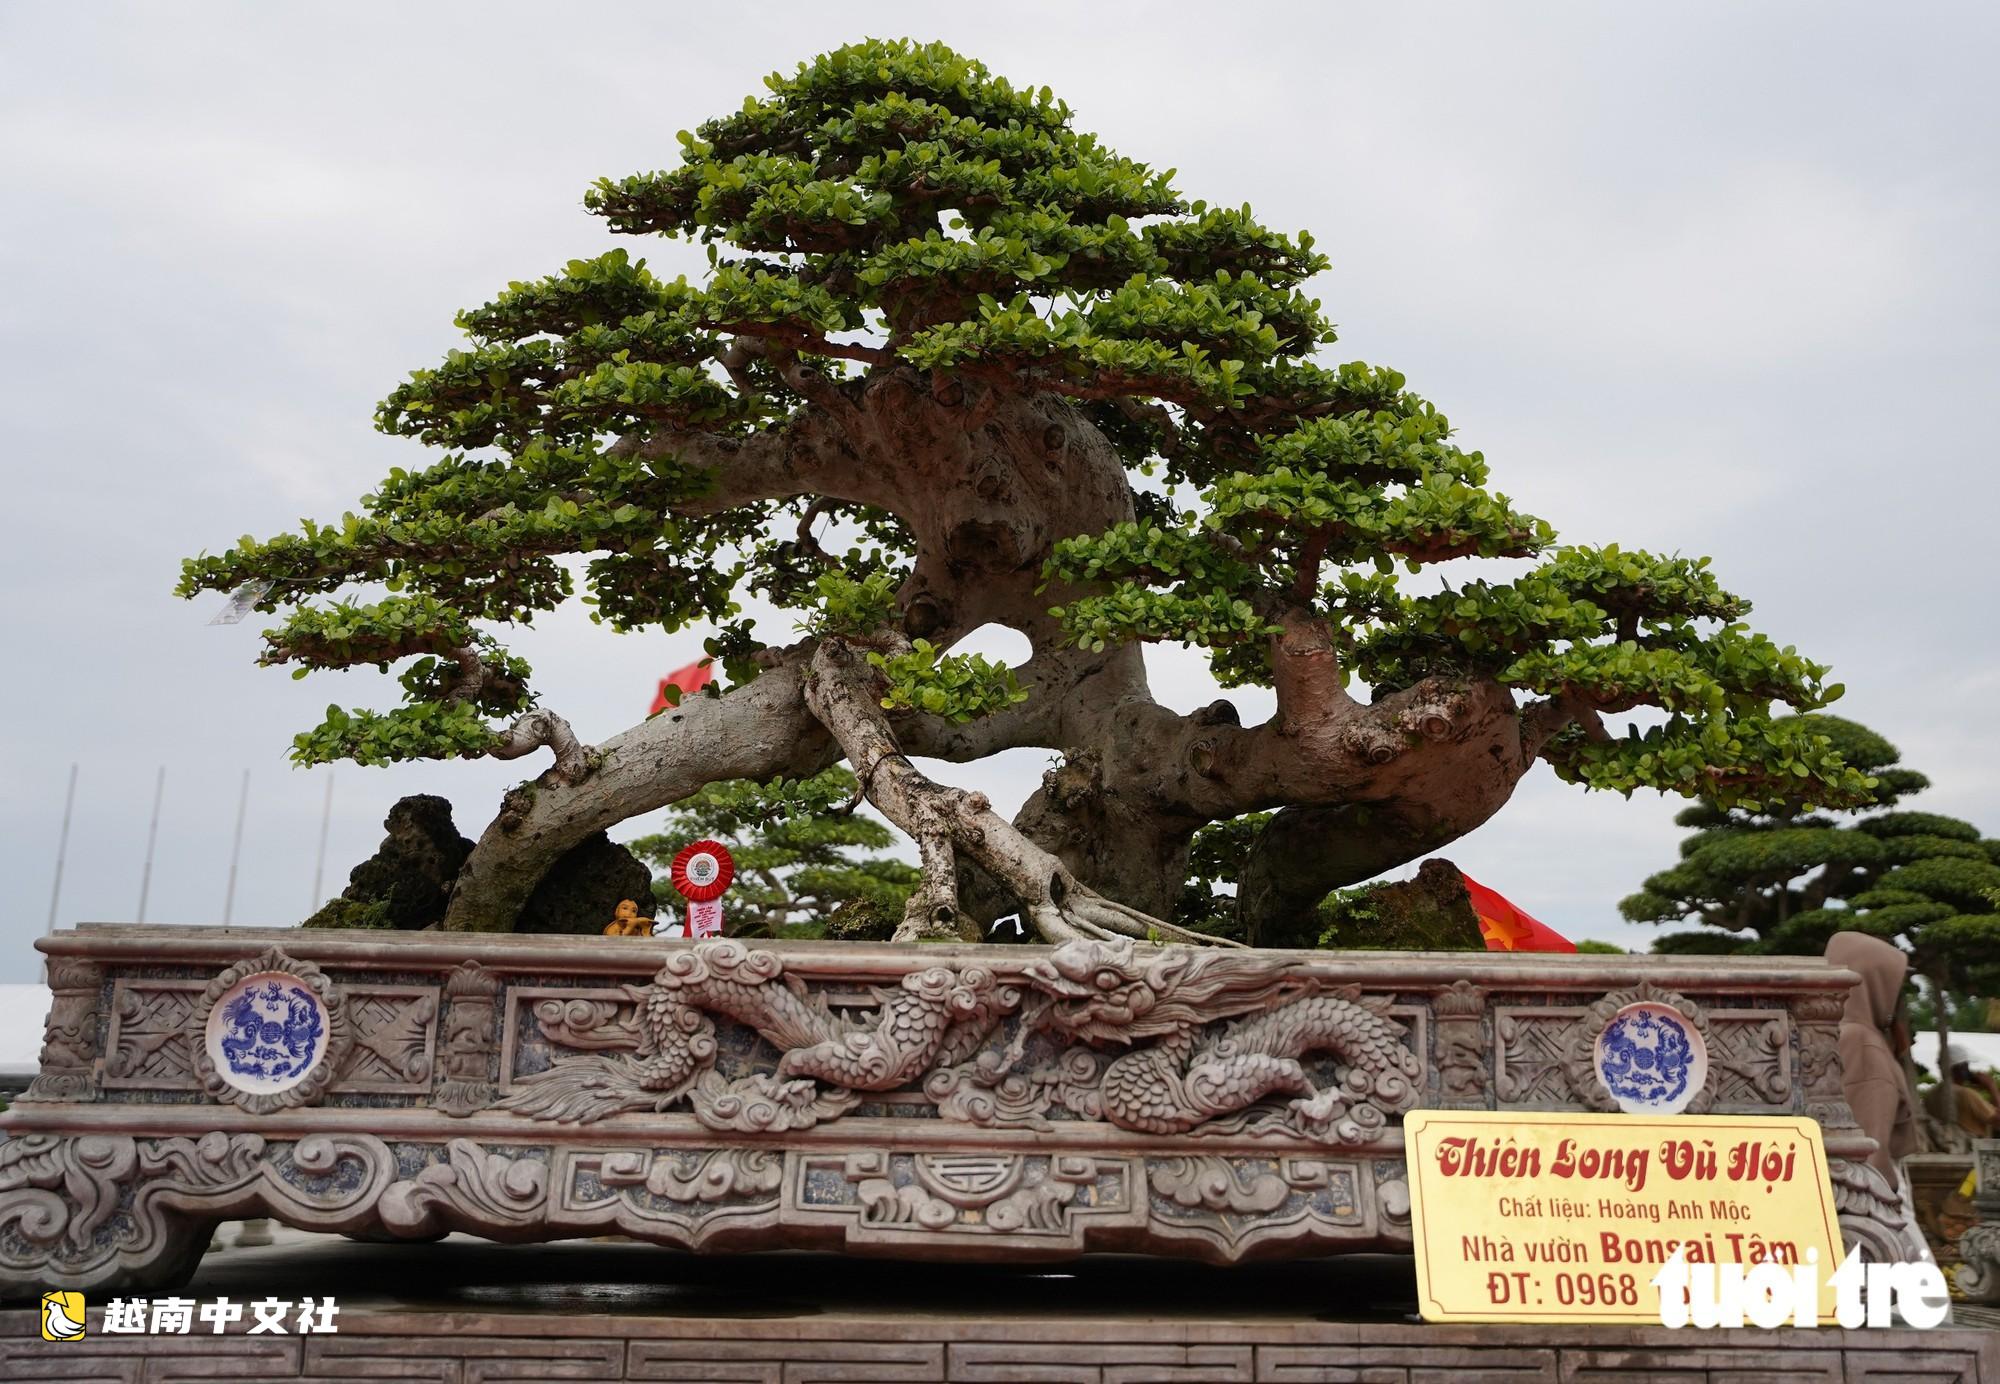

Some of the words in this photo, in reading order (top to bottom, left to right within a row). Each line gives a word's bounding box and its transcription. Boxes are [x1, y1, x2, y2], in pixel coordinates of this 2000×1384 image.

[1435, 1136, 1541, 1178] Thiên
[1550, 1138, 1649, 1192] Long
[1659, 1140, 1717, 1181] Vũ
[1727, 1141, 1796, 1194] Hội
[1499, 1195, 1543, 1217] Chất
[1550, 1198, 1591, 1221] liệu:
[1598, 1199, 1660, 1223] Hoàng
[1667, 1200, 1703, 1219] Anh
[1710, 1200, 1751, 1224] Mộc
[1462, 1235, 1514, 1262] Nhà
[1524, 1236, 1588, 1263] vườn
[1725, 1233, 1798, 1264] Tâm
[1487, 1272, 1542, 1305] ĐT:
[1555, 1273, 1638, 1306] 0968
